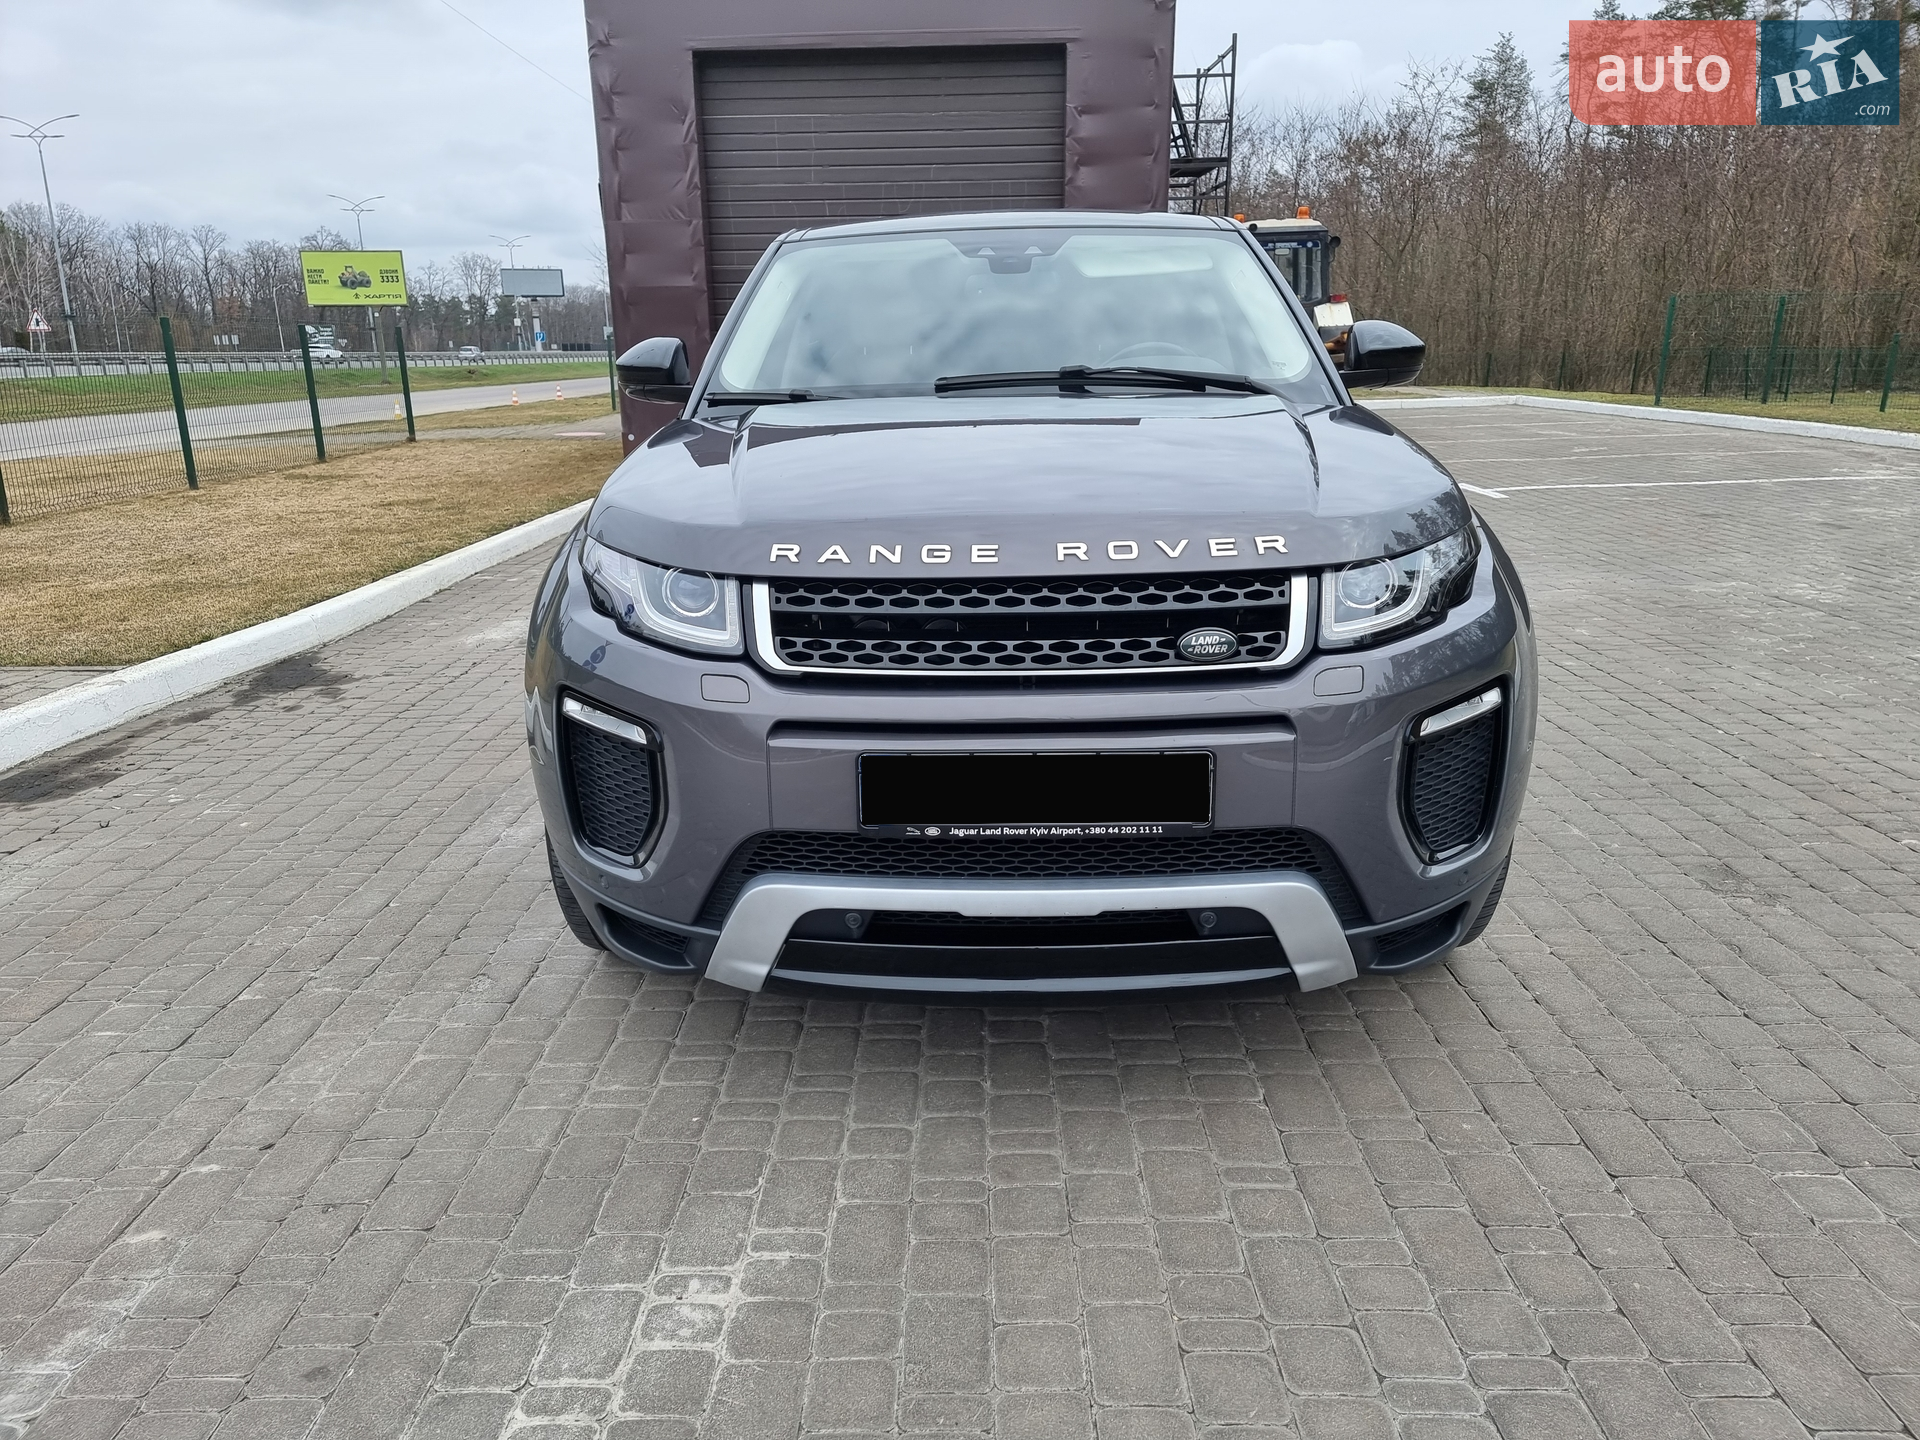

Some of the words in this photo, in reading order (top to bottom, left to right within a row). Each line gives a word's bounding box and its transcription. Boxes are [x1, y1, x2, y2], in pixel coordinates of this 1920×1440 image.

[379, 275, 400, 283] 3333
[769, 543, 999, 564] RANGE
[1056, 535, 1289, 562] ROVER
[1191, 636, 1219, 645] LAND
[1193, 645, 1228, 654] ROVER
[949, 827, 979, 837] Jaguar
[980, 827, 1001, 835] Land
[1003, 827, 1028, 835] Rover
[1029, 827, 1049, 837] Kyiv
[1050, 826, 1083, 836] Airport,
[1107, 826, 1119, 834] 44
[1121, 826, 1137, 834] 202
